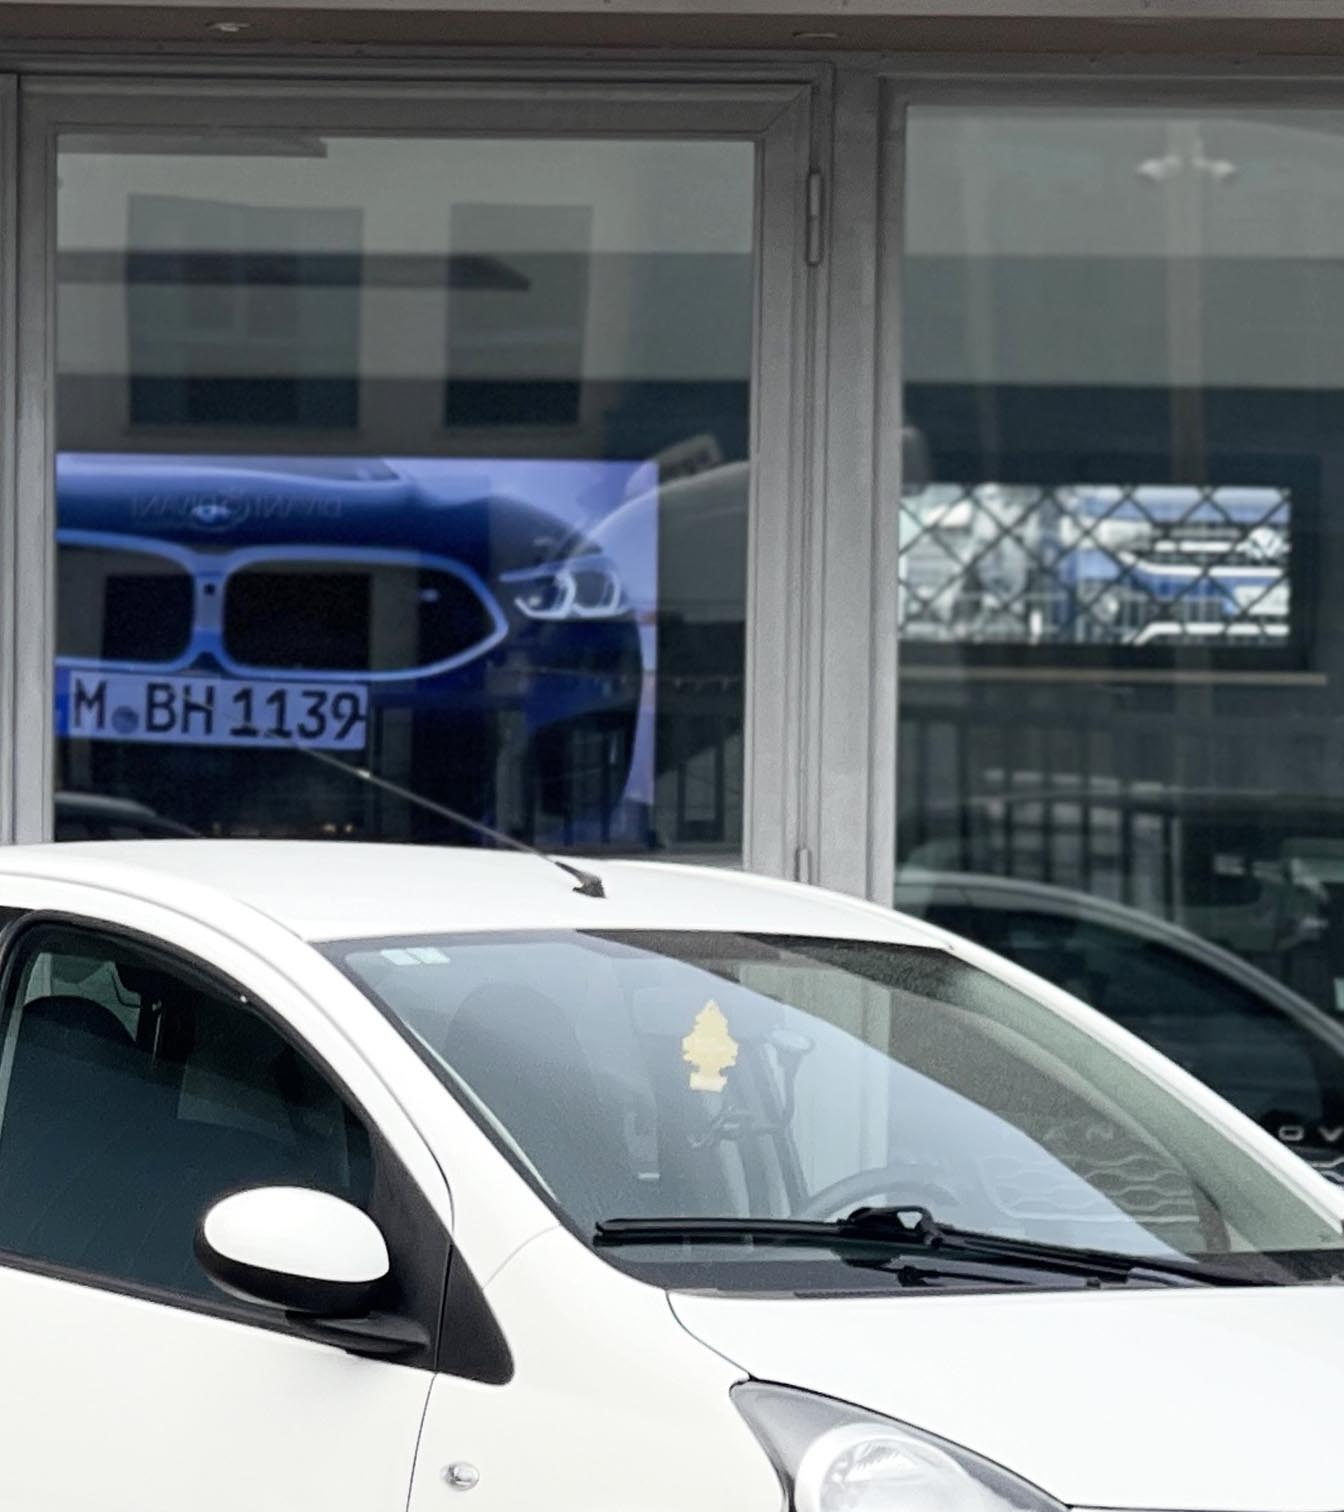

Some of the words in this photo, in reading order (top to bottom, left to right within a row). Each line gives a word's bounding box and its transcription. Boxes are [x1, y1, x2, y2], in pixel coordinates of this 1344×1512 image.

[74, 679, 106, 729] M
[145, 682, 215, 735] BH
[229, 687, 365, 740] 1139
